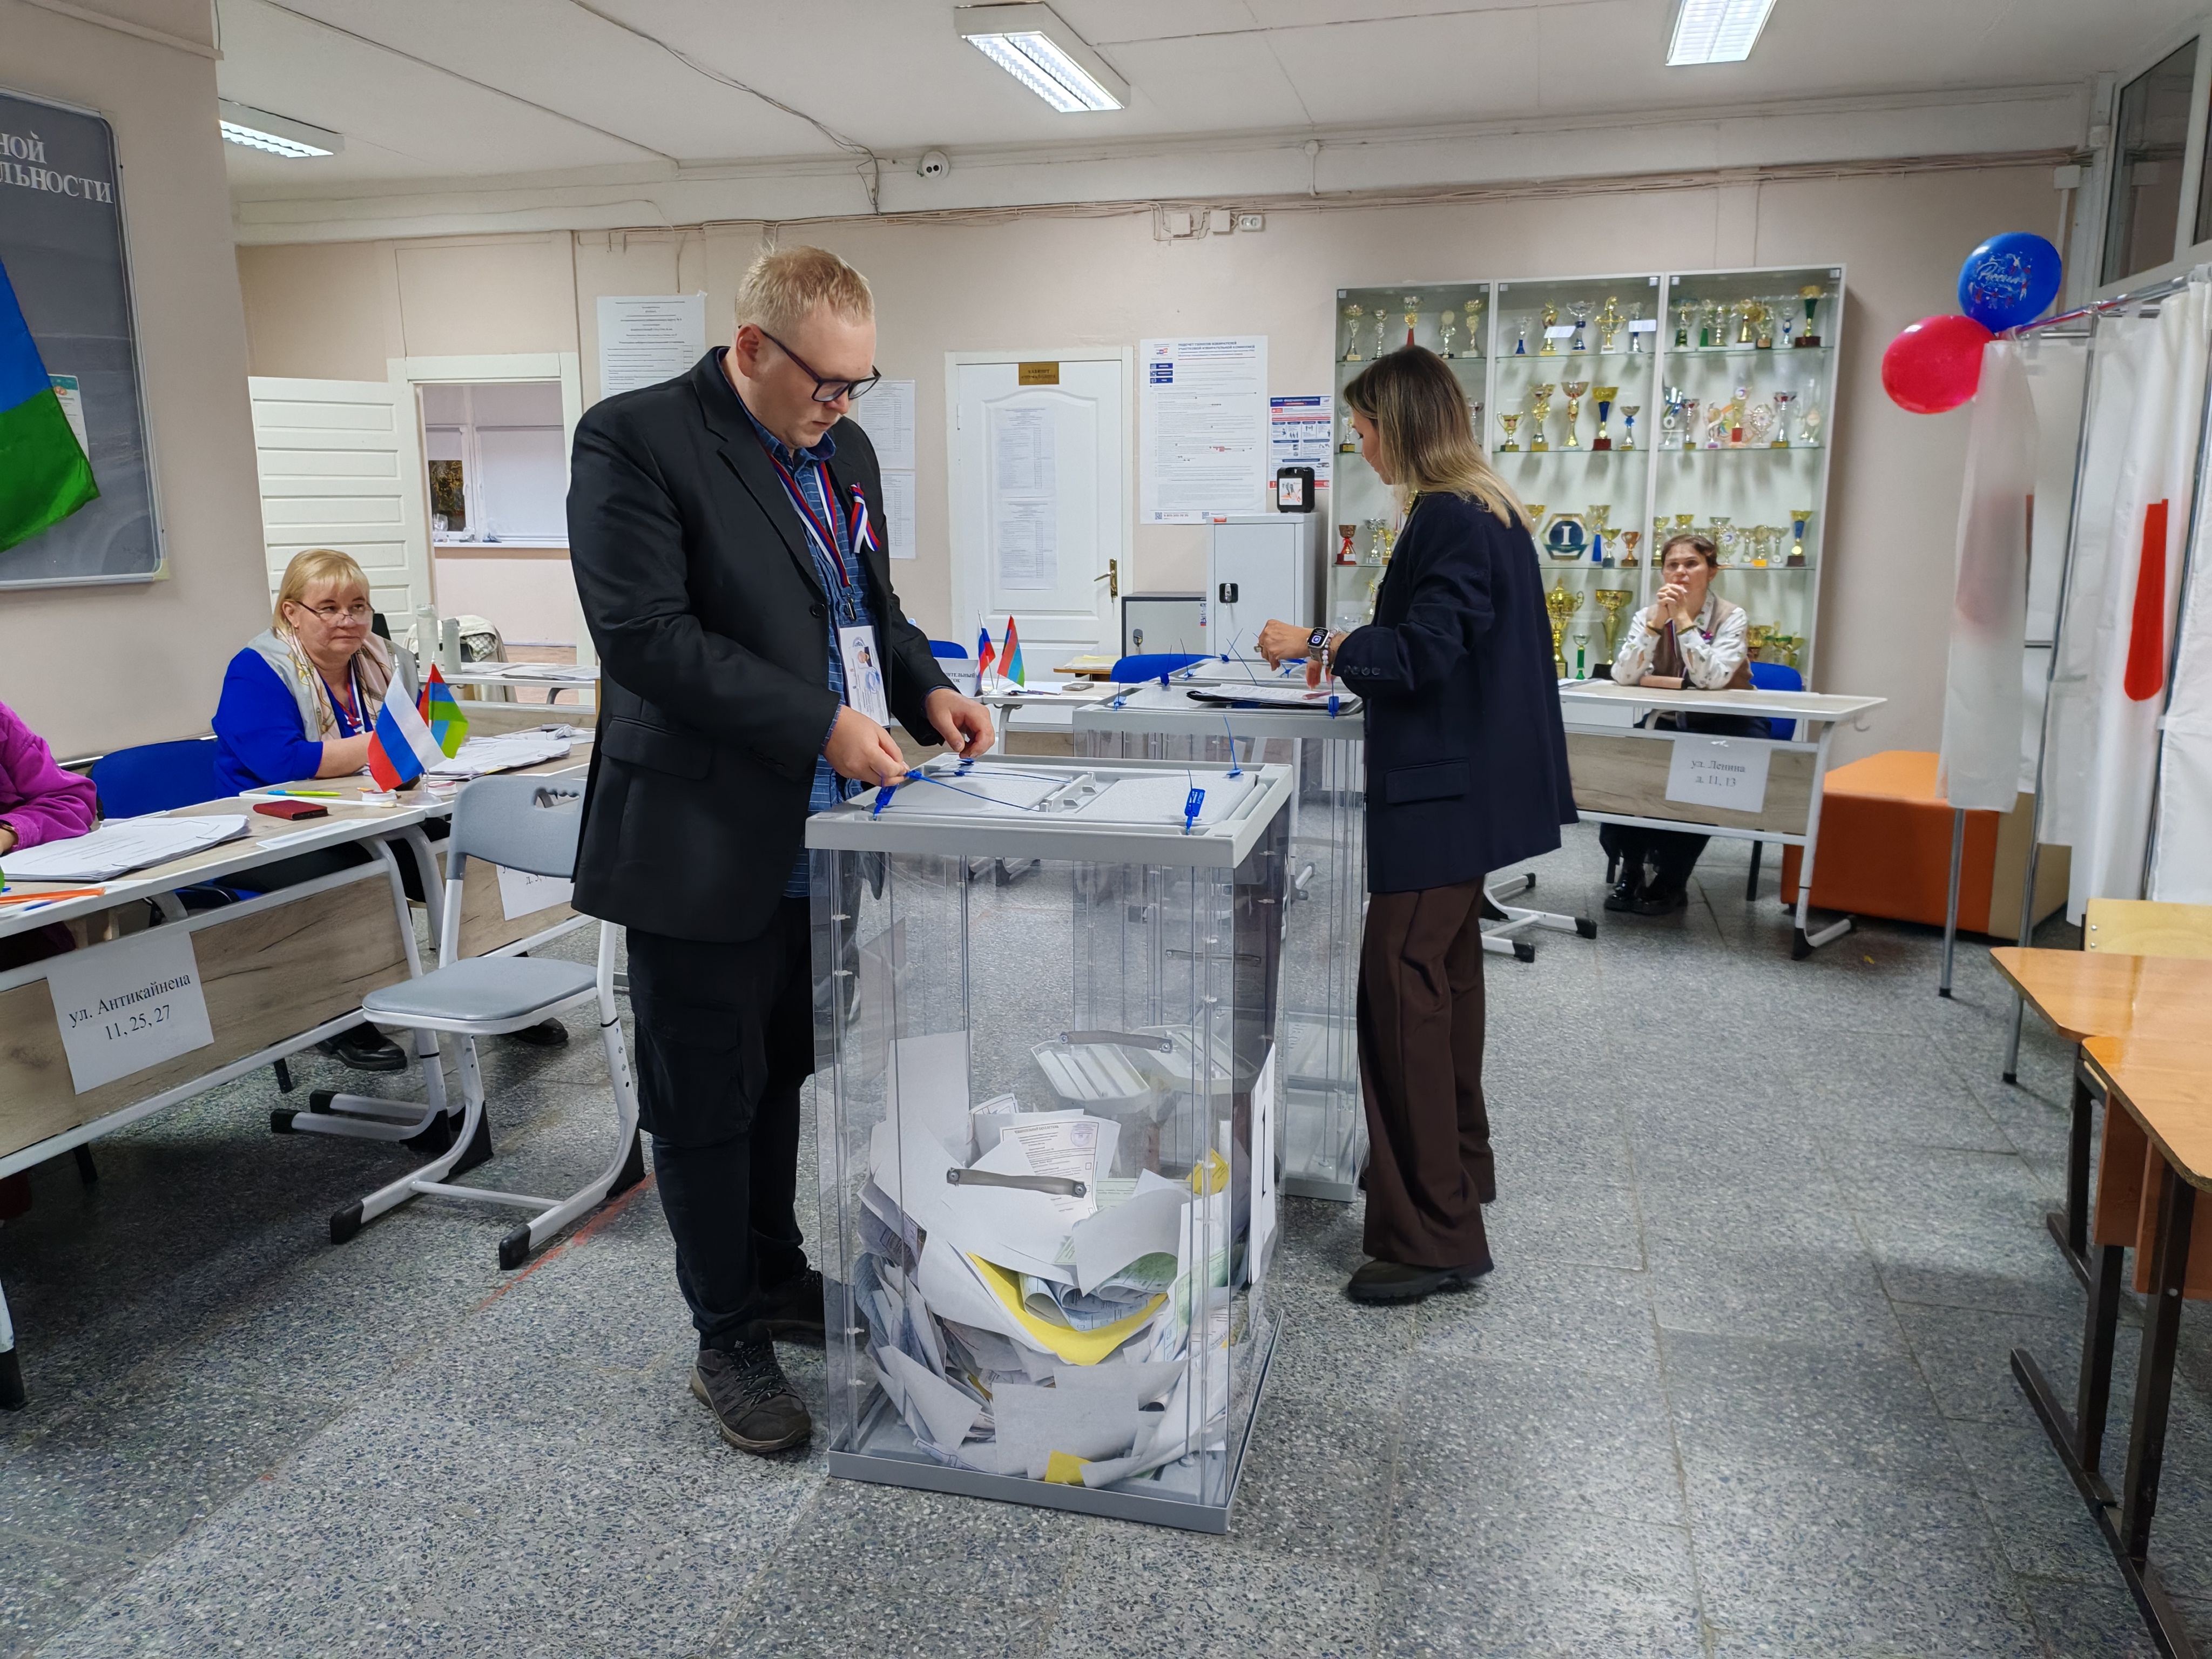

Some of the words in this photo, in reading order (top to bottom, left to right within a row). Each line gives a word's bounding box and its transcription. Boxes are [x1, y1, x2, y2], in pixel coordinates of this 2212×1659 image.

[1707, 760, 1745, 773] Ленина
[69, 1009, 93, 1028] ул.
[98, 974, 191, 1015] Антикайнена
[105, 1022, 128, 1040] 11,
[129, 1013, 152, 1031] 25,
[154, 1004, 170, 1023] 27
